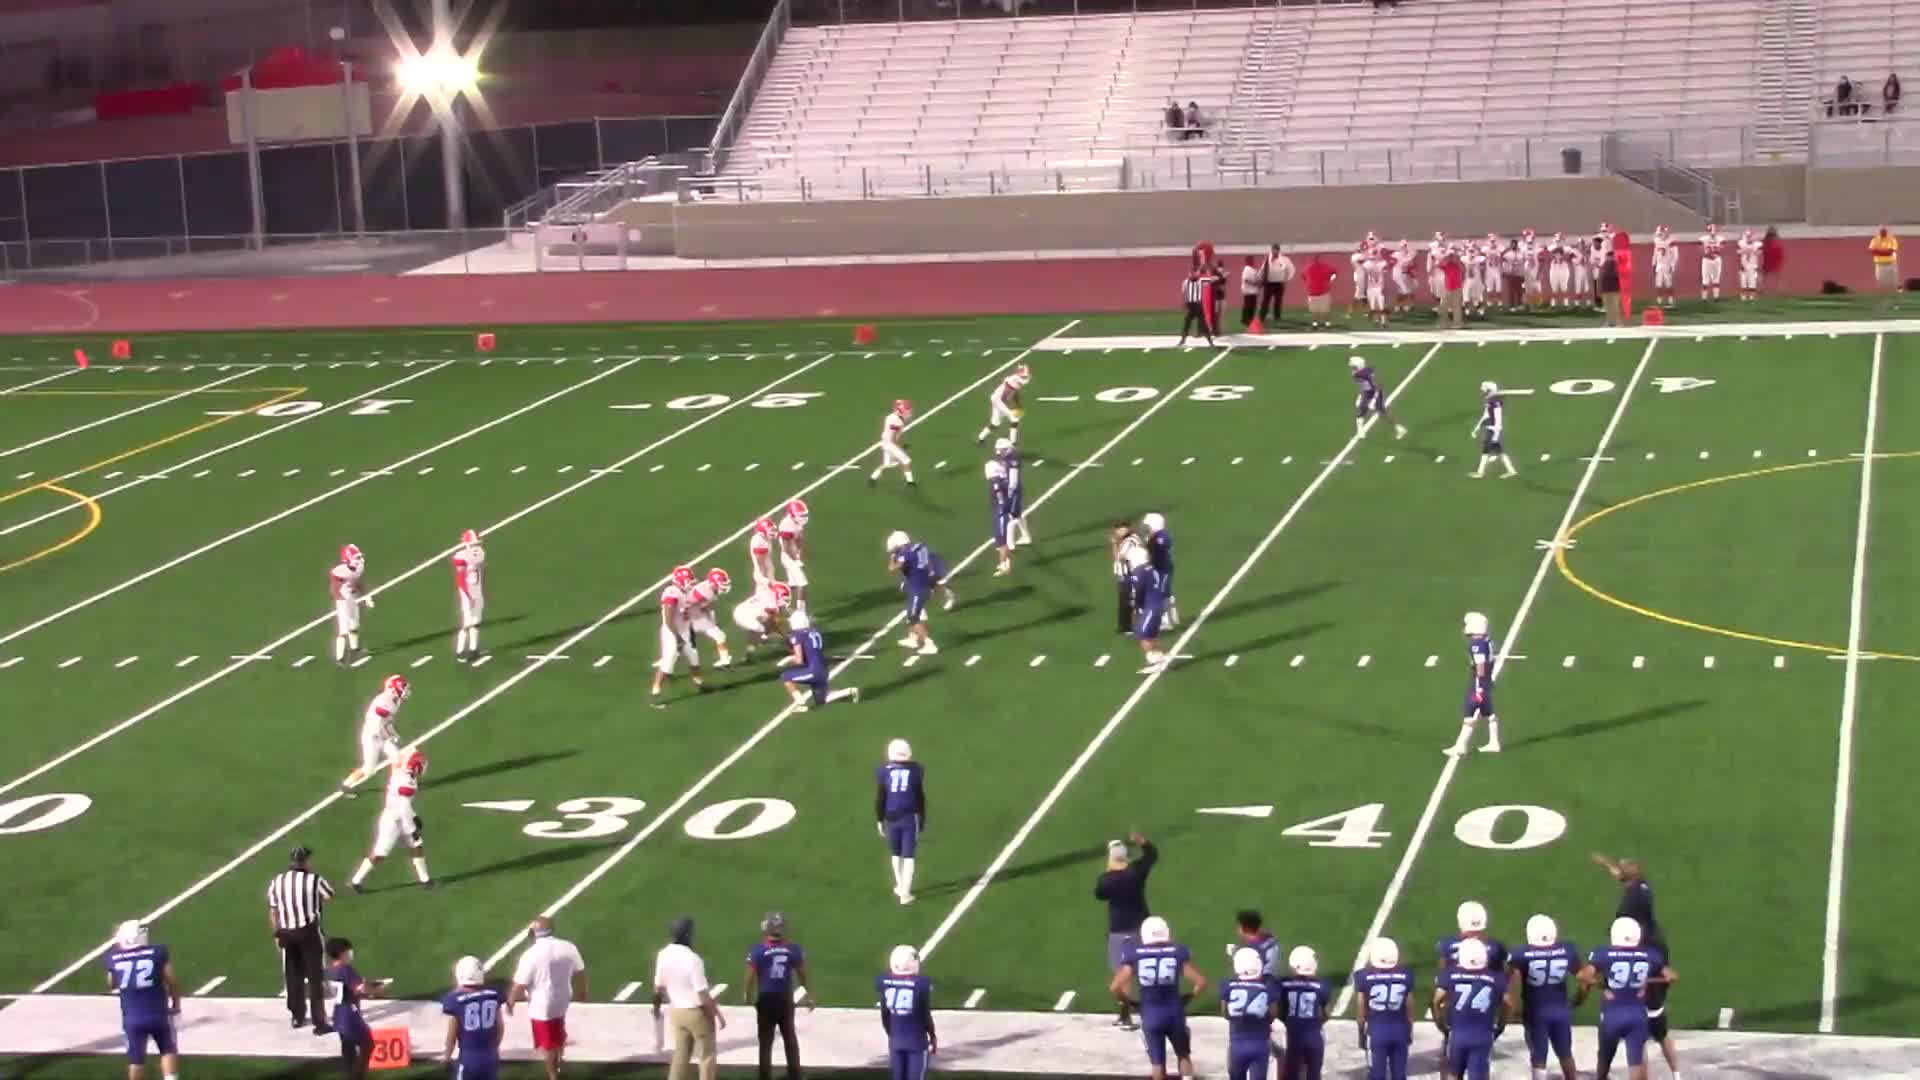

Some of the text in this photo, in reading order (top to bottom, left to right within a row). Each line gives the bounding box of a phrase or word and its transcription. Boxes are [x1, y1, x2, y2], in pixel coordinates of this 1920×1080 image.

[522, 796, 796, 839] 30
[1282, 803, 1566, 850] 40
[114, 959, 155, 989] 72
[1528, 959, 1569, 986] 55
[1607, 960, 1649, 988] 33
[1227, 988, 1269, 1018] 24
[1368, 983, 1407, 1012] 25
[1454, 983, 1493, 1013] 74
[373, 1037, 405, 1063] 30
